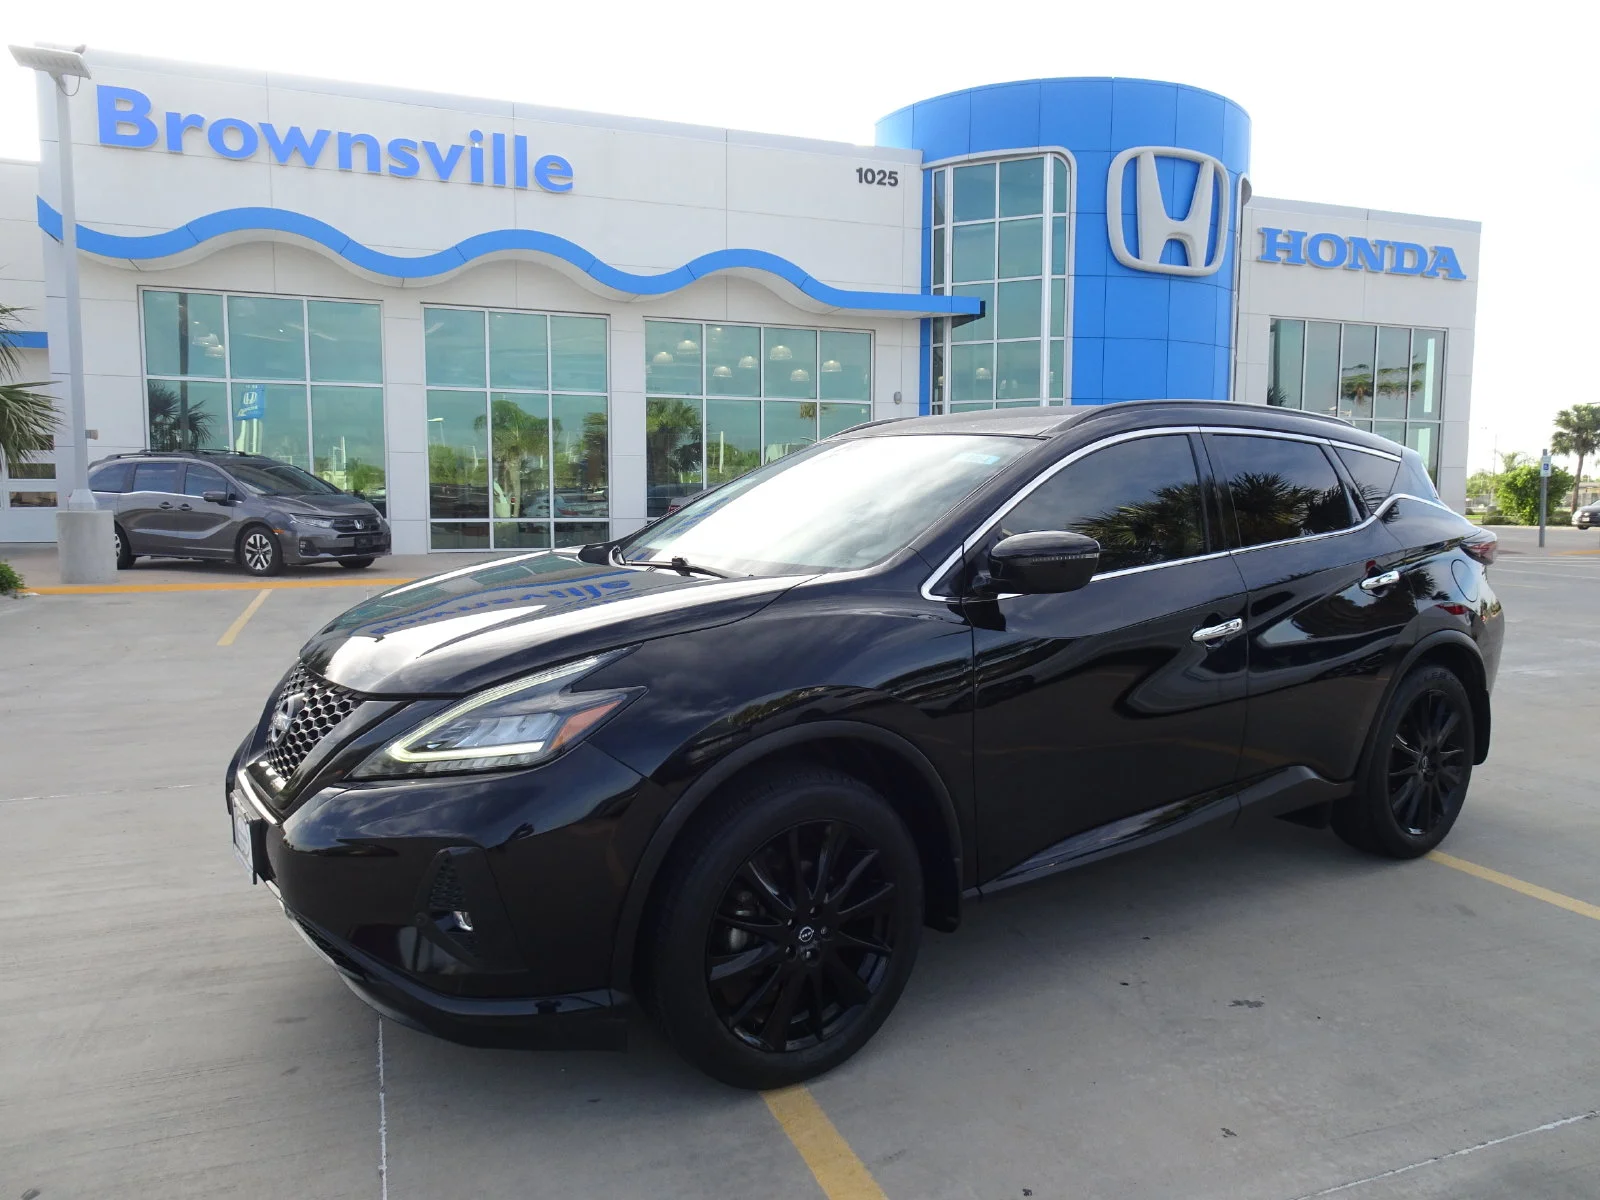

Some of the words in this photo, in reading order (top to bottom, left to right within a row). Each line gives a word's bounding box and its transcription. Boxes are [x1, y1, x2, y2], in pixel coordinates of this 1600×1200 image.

[97, 84, 574, 193] Brownsville
[856, 167, 899, 187] 1025
[1258, 227, 1467, 281] HONDA
